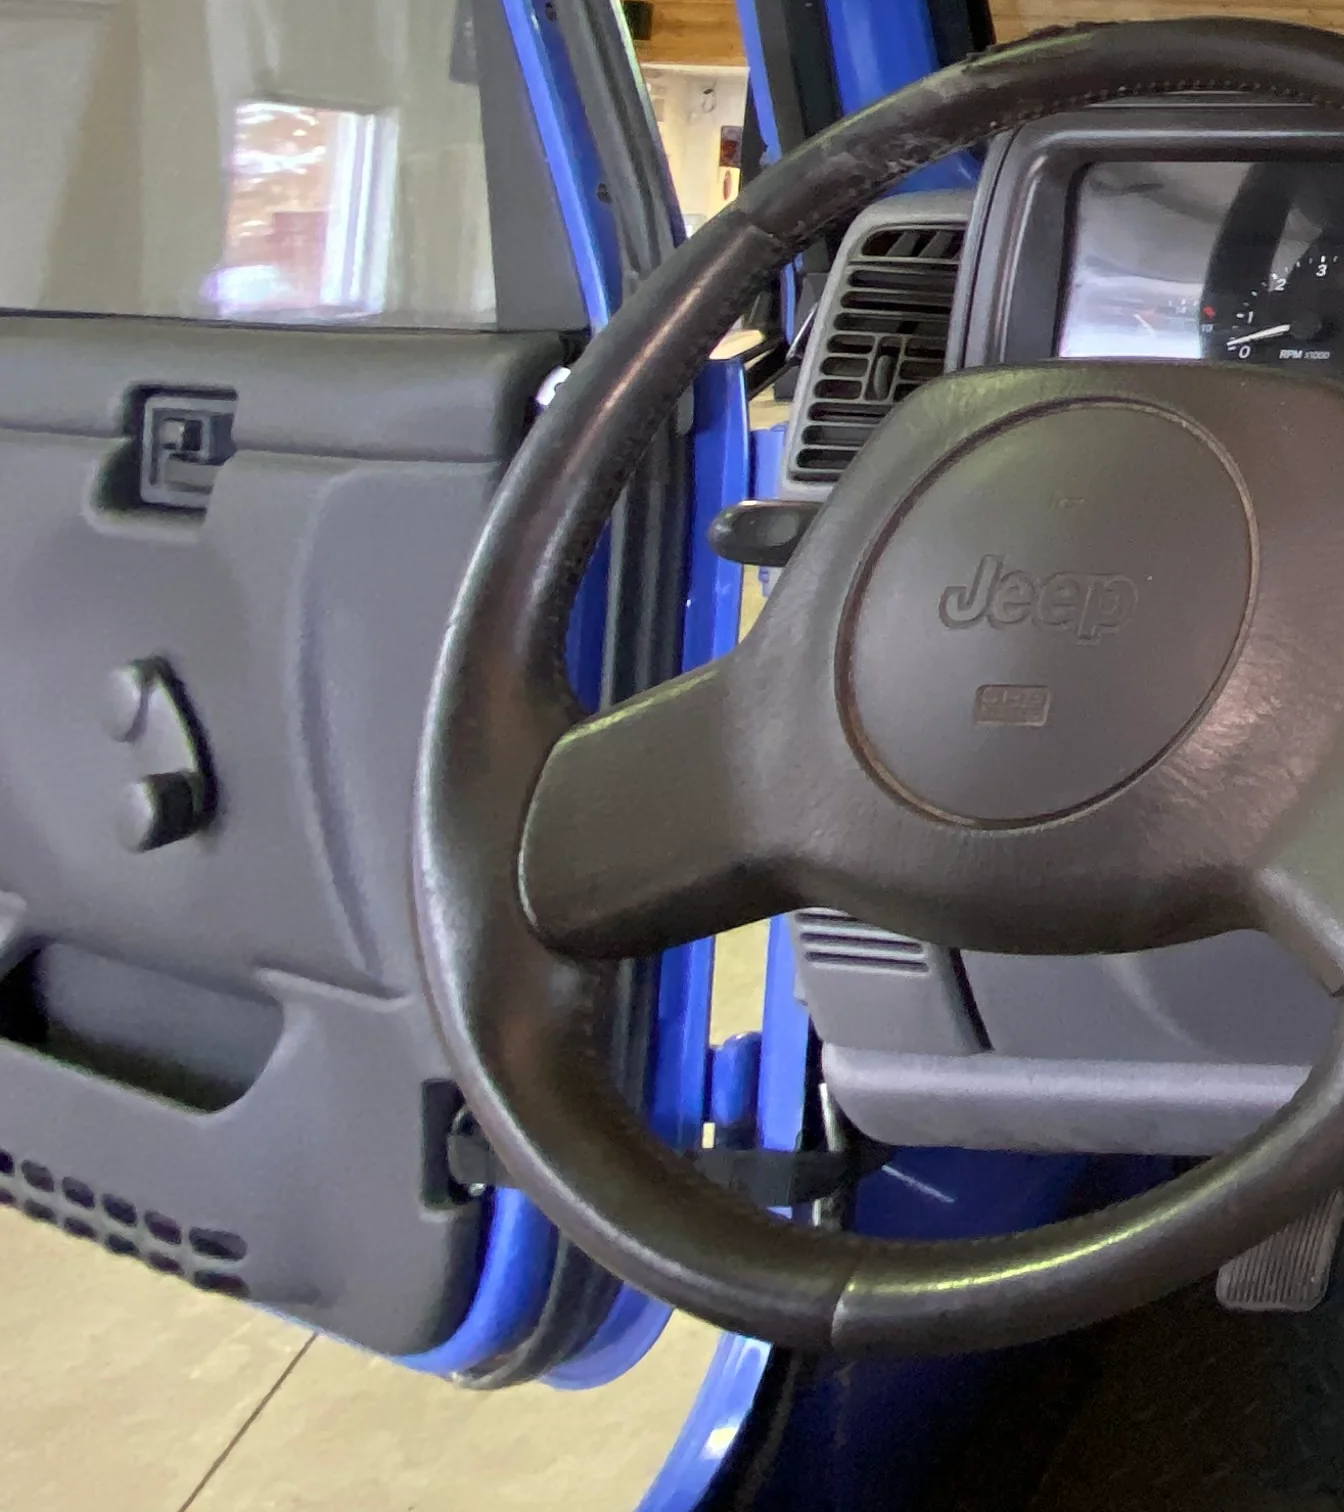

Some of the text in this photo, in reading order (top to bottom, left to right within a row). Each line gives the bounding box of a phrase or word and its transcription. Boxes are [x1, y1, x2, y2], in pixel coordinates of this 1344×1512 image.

[1315, 264, 1328, 278] 3
[1273, 277, 1287, 291] 2
[1246, 310, 1254, 324] 1
[1238, 345, 1251, 359] 0
[1278, 349, 1303, 360] RPM
[938, 553, 1140, 646] Jeep
